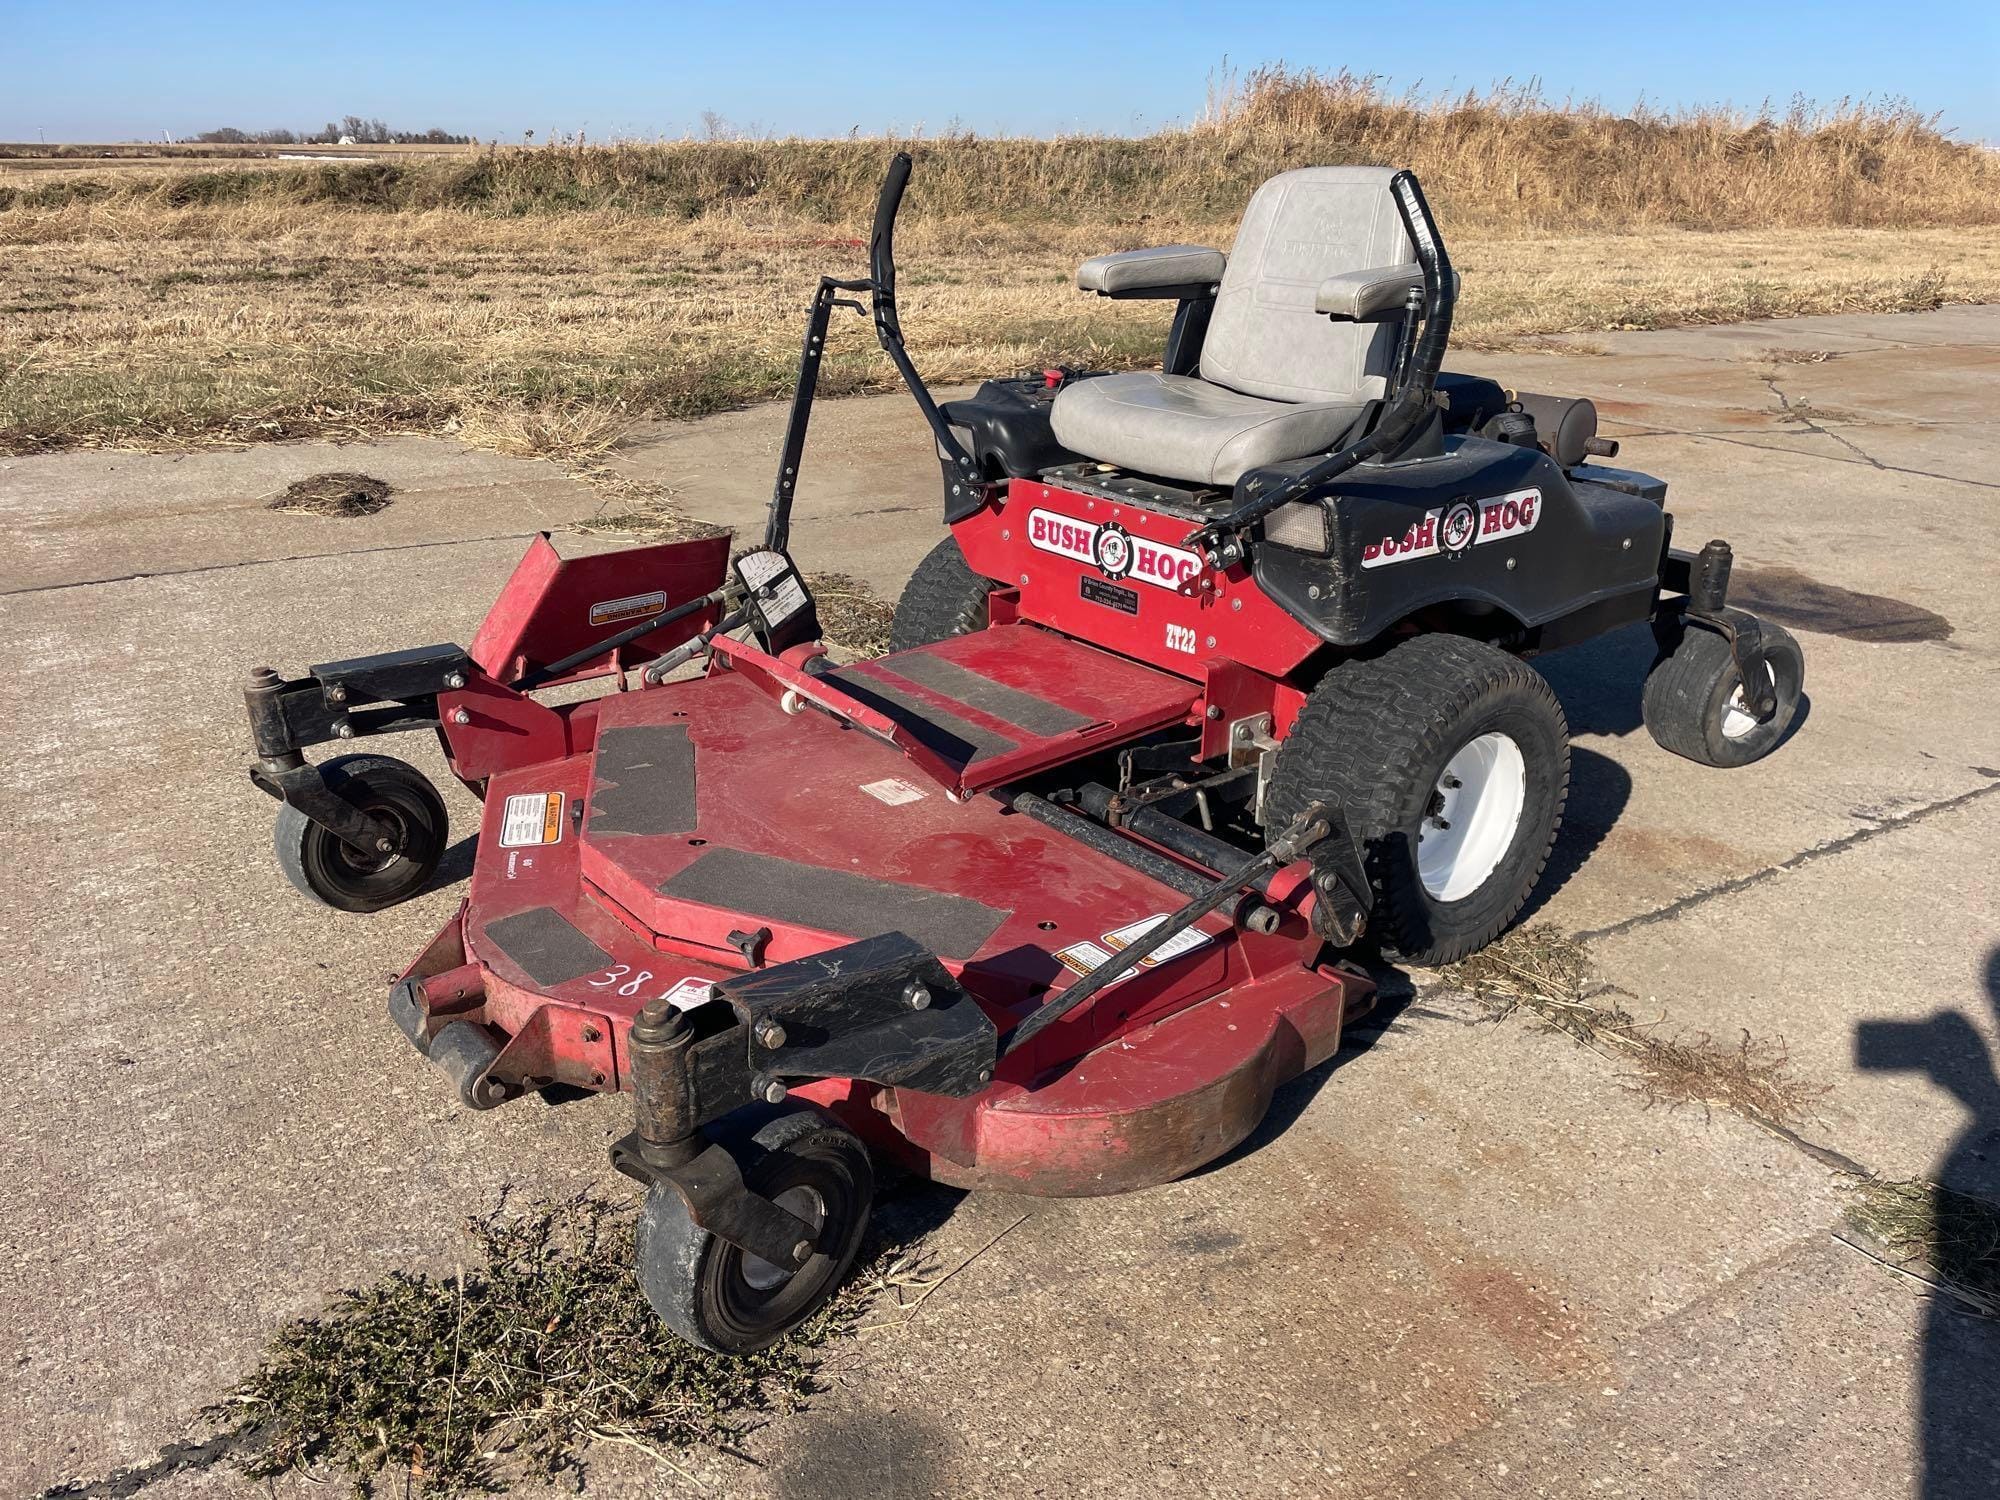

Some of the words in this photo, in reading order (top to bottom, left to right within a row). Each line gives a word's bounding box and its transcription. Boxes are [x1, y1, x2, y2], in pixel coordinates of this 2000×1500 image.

[1483, 497, 1535, 535] HOG
[1033, 516, 1092, 557] BUSH
[1138, 547, 1193, 587] HOG
[607, 608, 642, 620] WARNING
[1165, 622, 1197, 655] ZT22
[548, 806, 557, 829] WARNING
[587, 964, 654, 996] 38
[1060, 954, 1092, 975] ARNING
